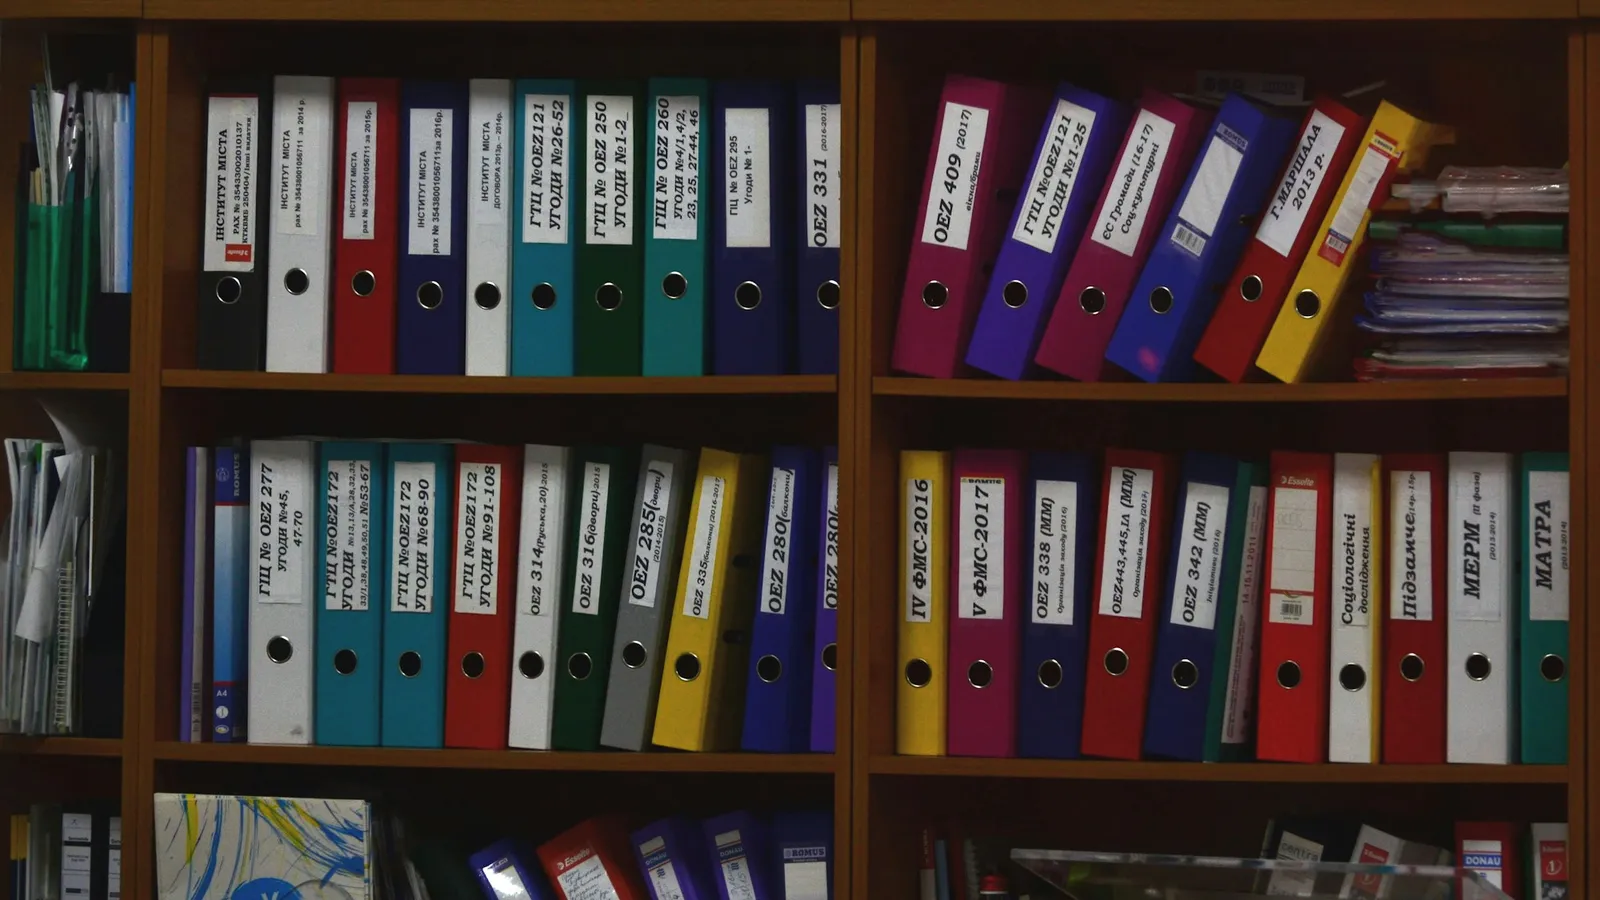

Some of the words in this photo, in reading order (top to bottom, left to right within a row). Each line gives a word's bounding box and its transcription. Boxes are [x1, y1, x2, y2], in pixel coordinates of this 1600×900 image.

[364, 108, 372, 132] 2015р.
[434, 110, 442, 138] 2016р.
[551, 100, 563, 167] №26-52
[595, 102, 606, 134] 250
[658, 98, 669, 131] 260
[689, 110, 698, 126] 46
[956, 109, 971, 150] (2017)
[218, 129, 227, 171] МІСТА
[365, 135, 371, 143] за
[531, 103, 544, 187] №OEZ121
[595, 139, 606, 173] OEZ
[657, 136, 668, 169] OEZ
[689, 131, 699, 170] 27-44,
[295, 203, 300, 212] №
[299, 127, 303, 135] за
[419, 151, 427, 180] МІСТА
[745, 158, 752, 170] №
[814, 159, 827, 196] 331
[943, 153, 961, 194] 409
[1024, 197, 1044, 235] ГТЦ
[1036, 115, 1072, 196] №OEZ121
[1042, 178, 1069, 238] УГОДИ
[1061, 122, 1087, 178] №1-25
[1103, 222, 1114, 239] ЄС
[1110, 167, 1136, 221] Громади
[1131, 123, 1153, 166] (16-17)
[1271, 125, 1321, 220] Г.МАРШАЛА
[1292, 167, 1315, 210] 2013
[1312, 153, 1326, 170] р.
[281, 164, 289, 209] ІНСТИТУТ
[550, 171, 563, 229] УГОДИ
[595, 180, 605, 198] №
[615, 169, 628, 227] УГОДИ
[656, 176, 667, 194] №
[674, 175, 684, 219] УГОДИ
[688, 175, 697, 194] 25,
[730, 181, 737, 193] №
[1121, 142, 1160, 234] Соц-культурні
[216, 175, 226, 241] ІНСТИТУТ
[234, 204, 240, 213] №
[362, 209, 368, 217] №
[418, 182, 426, 228] ІНСТИТУТ
[531, 192, 542, 227] ГТЦ
[595, 203, 607, 237] ГТЦ
[688, 199, 697, 219] 23,
[934, 199, 953, 243] OEZ
[432, 226, 439, 235] №
[814, 204, 827, 247] OEZ
[262, 463, 272, 497] 277
[360, 465, 369, 515] №53-67
[1120, 469, 1136, 508] (ММ)
[261, 502, 271, 536] OEZ
[279, 490, 289, 523] №45,
[327, 471, 339, 557] №OEZ172
[417, 479, 429, 546] №68-90
[464, 472, 477, 558] №OEZ172
[482, 466, 495, 542] №91-108
[1040, 498, 1054, 537] (ММ)
[1060, 507, 1068, 532] (2016)
[1193, 502, 1210, 542] (ММ)
[294, 510, 302, 547] 47-70
[399, 481, 411, 567] №OEZ172
[653, 515, 665, 562] (2014-2015)
[913, 480, 928, 589] ФМС-2016
[973, 486, 988, 597] ФМС-2017
[1464, 520, 1480, 599] МЕРМ
[1473, 472, 1482, 501] фаза)
[260, 542, 271, 560] №
[278, 528, 288, 571] УГОДИ
[1039, 542, 1050, 576] 338
[1133, 548, 1143, 598] Організація
[1138, 518, 1147, 546] заходу
[1188, 546, 1202, 580] 342
[1535, 500, 1552, 590] МАТРА
[327, 562, 338, 598] ГТЦ
[342, 551, 355, 610] УГОДИ
[416, 550, 428, 610] УГОДИ
[463, 563, 475, 599] ГТЦ
[480, 547, 493, 607] УГОДИ
[632, 555, 649, 599] OEZ
[1206, 556, 1217, 603] Ініціативи
[1212, 530, 1221, 555] (2016)
[1342, 514, 1356, 624] Соціологічні
[1359, 527, 1369, 614] дослідження
[398, 572, 409, 608] ГТЦ
[531, 586, 541, 615] OEZ
[580, 573, 592, 608] OEZ
[693, 590, 703, 615] OEZ
[769, 569, 783, 613] OEZ
[913, 595, 926, 618] IV
[973, 603, 986, 616] V
[1037, 581, 1048, 618] OEZ
[1183, 585, 1197, 622] OEZ
[1466, 856, 1501, 865] DONAU
